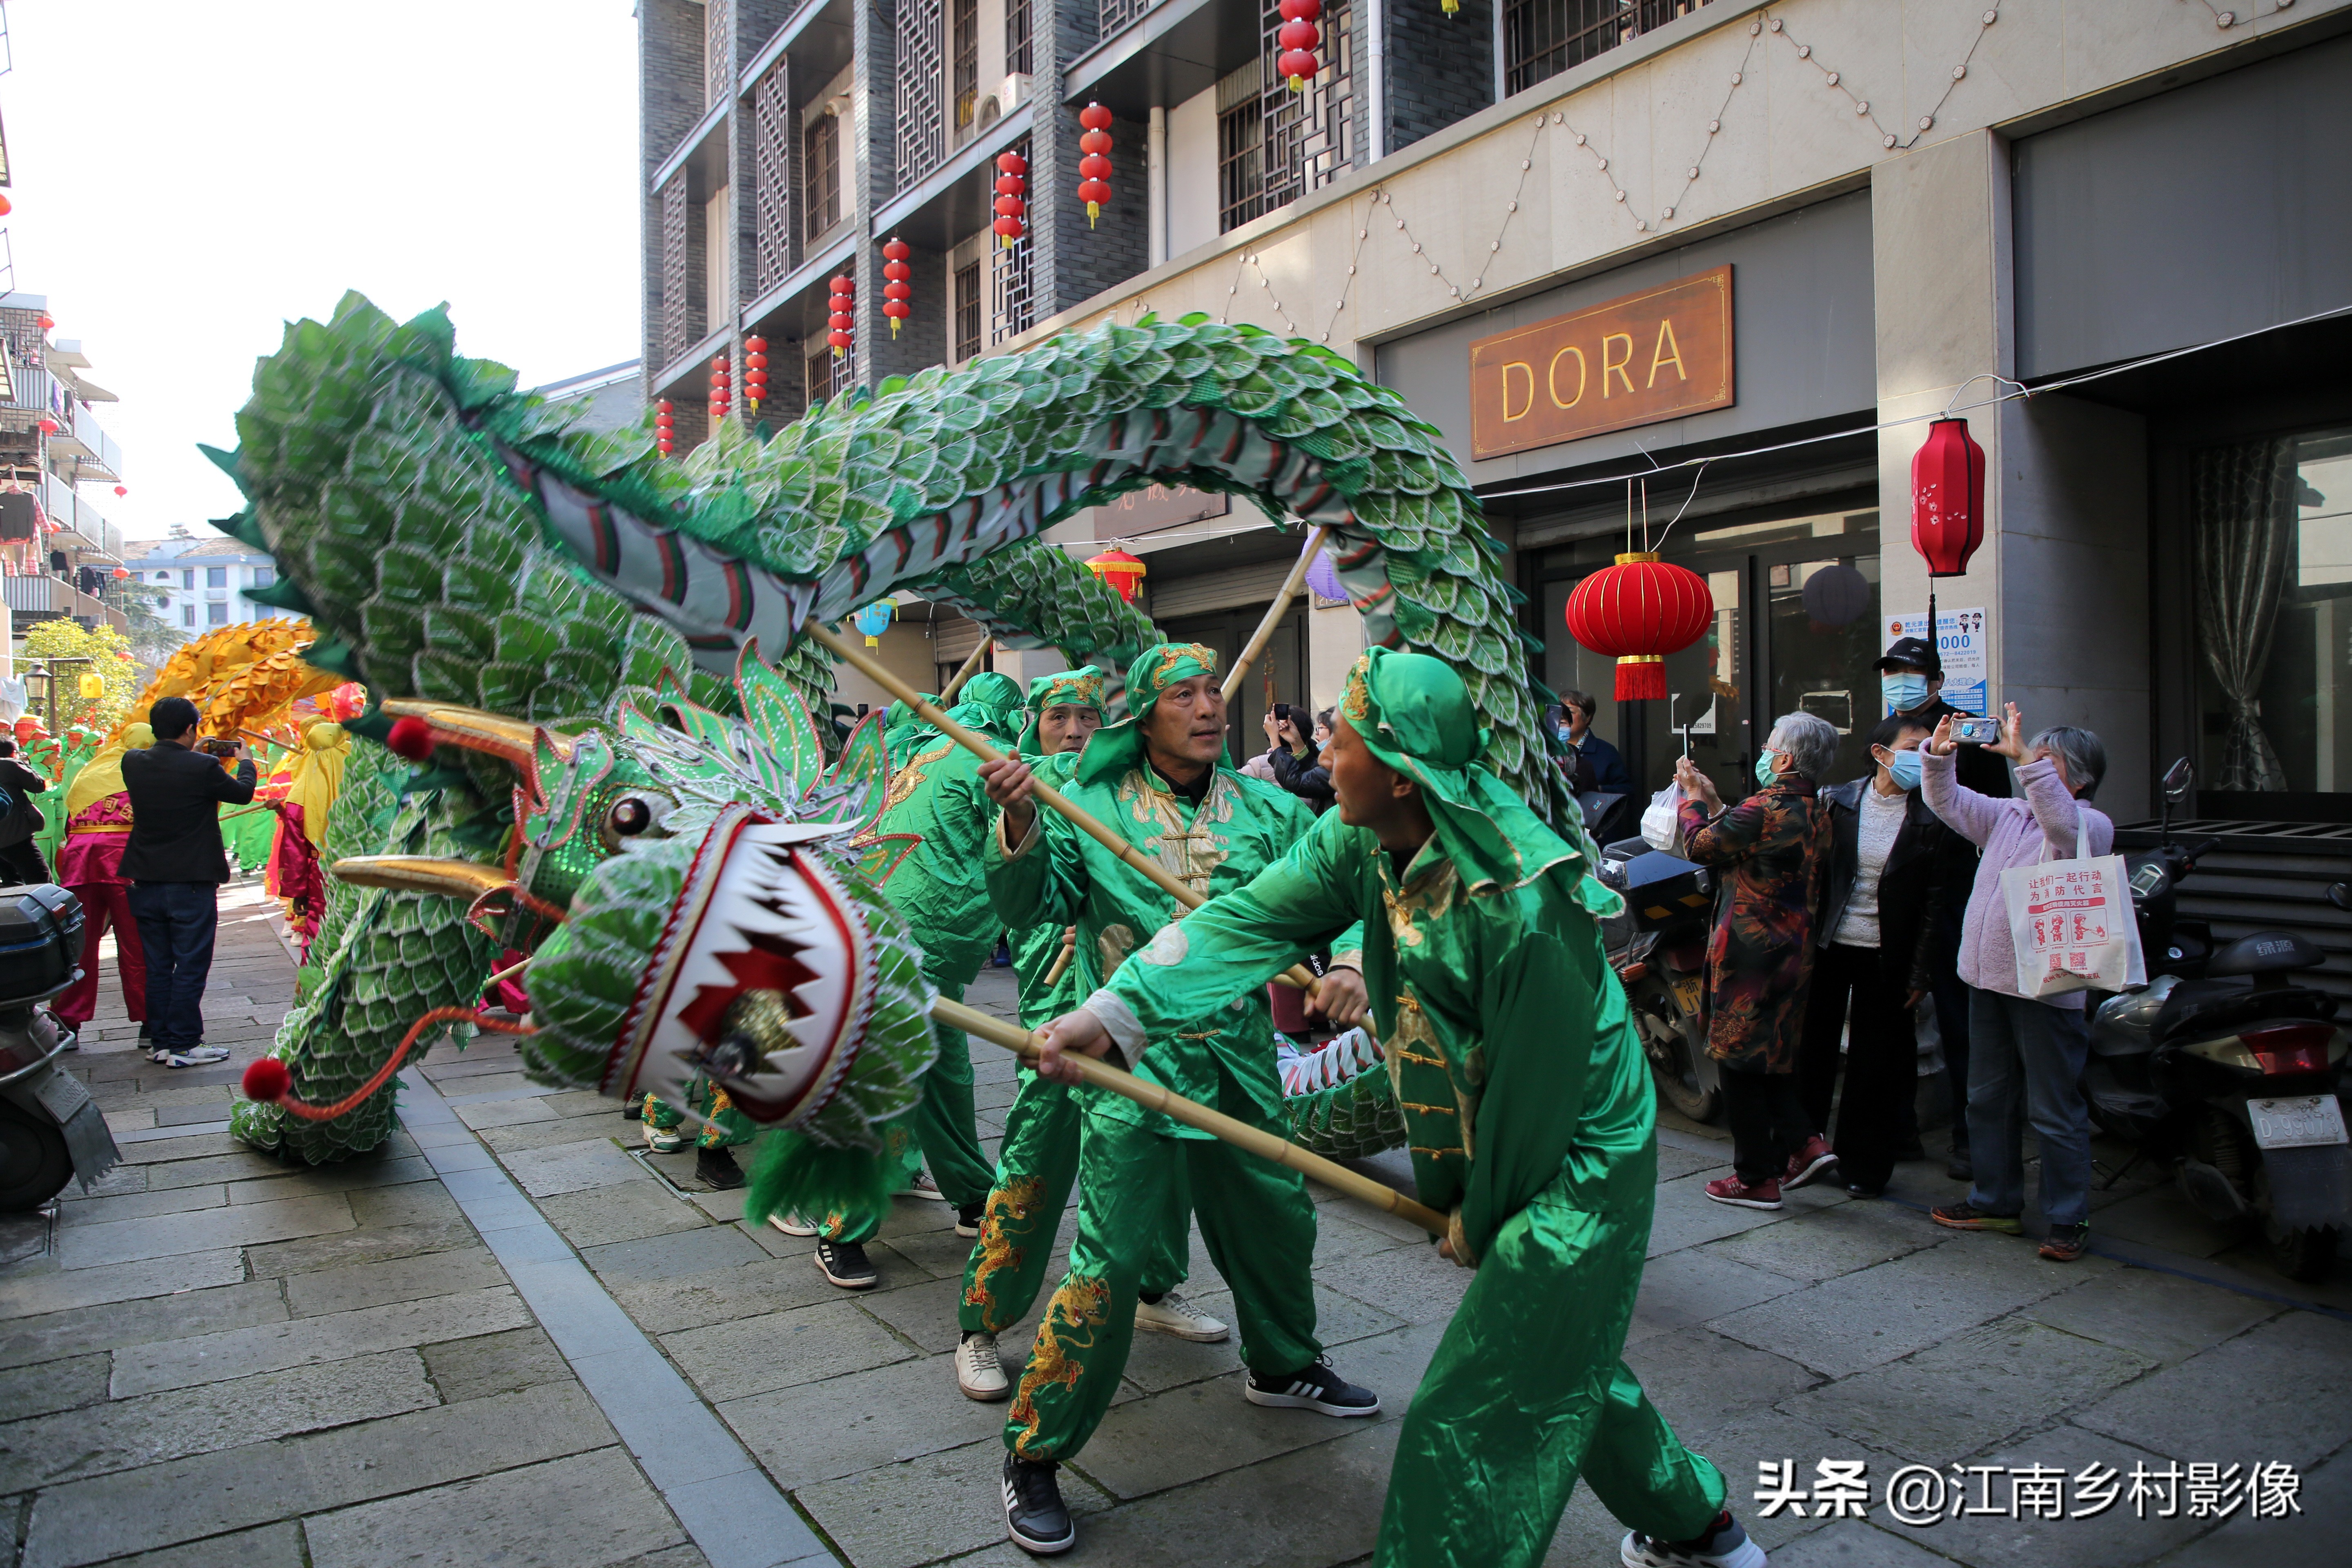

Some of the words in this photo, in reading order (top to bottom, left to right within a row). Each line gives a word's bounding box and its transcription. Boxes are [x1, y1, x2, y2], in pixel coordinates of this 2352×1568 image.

[1502, 318, 1686, 423] DORA
[1905, 618, 1958, 628] 乾元派出提醒您:
[2029, 870, 2102, 889] 让我们一起行动
[2256, 940, 2294, 956] 绿源
